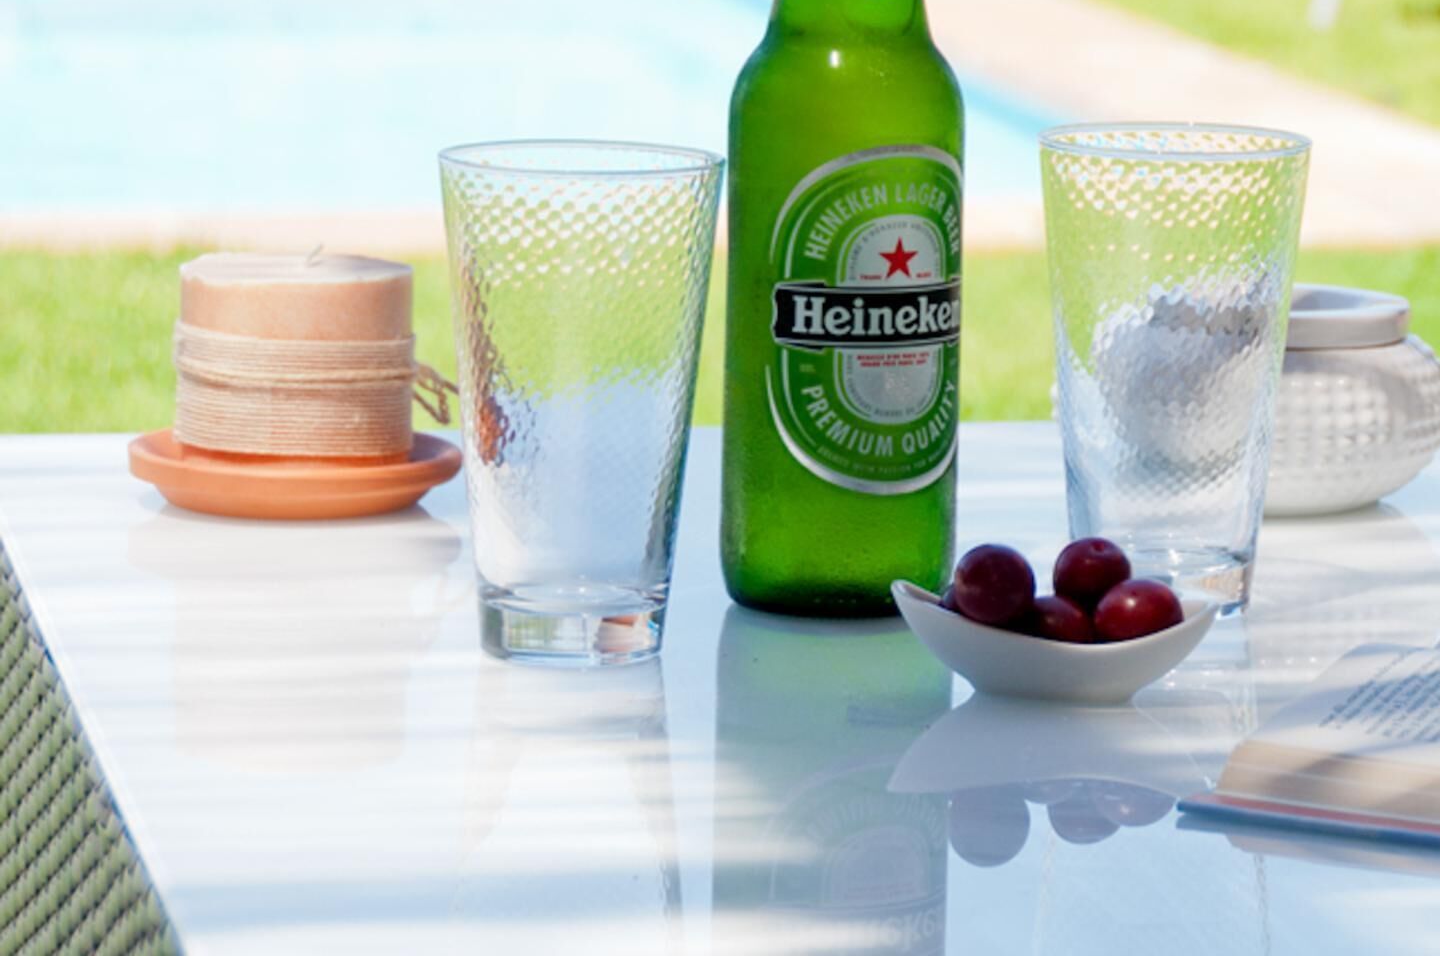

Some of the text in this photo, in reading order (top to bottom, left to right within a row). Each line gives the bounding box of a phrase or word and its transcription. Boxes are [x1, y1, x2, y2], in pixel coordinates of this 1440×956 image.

[804, 183, 888, 261] HEINEKEN
[895, 181, 947, 215] LAGER
[942, 204, 960, 256] BEER
[801, 384, 894, 457] PREMIUM
[901, 379, 956, 455] QUALITY
